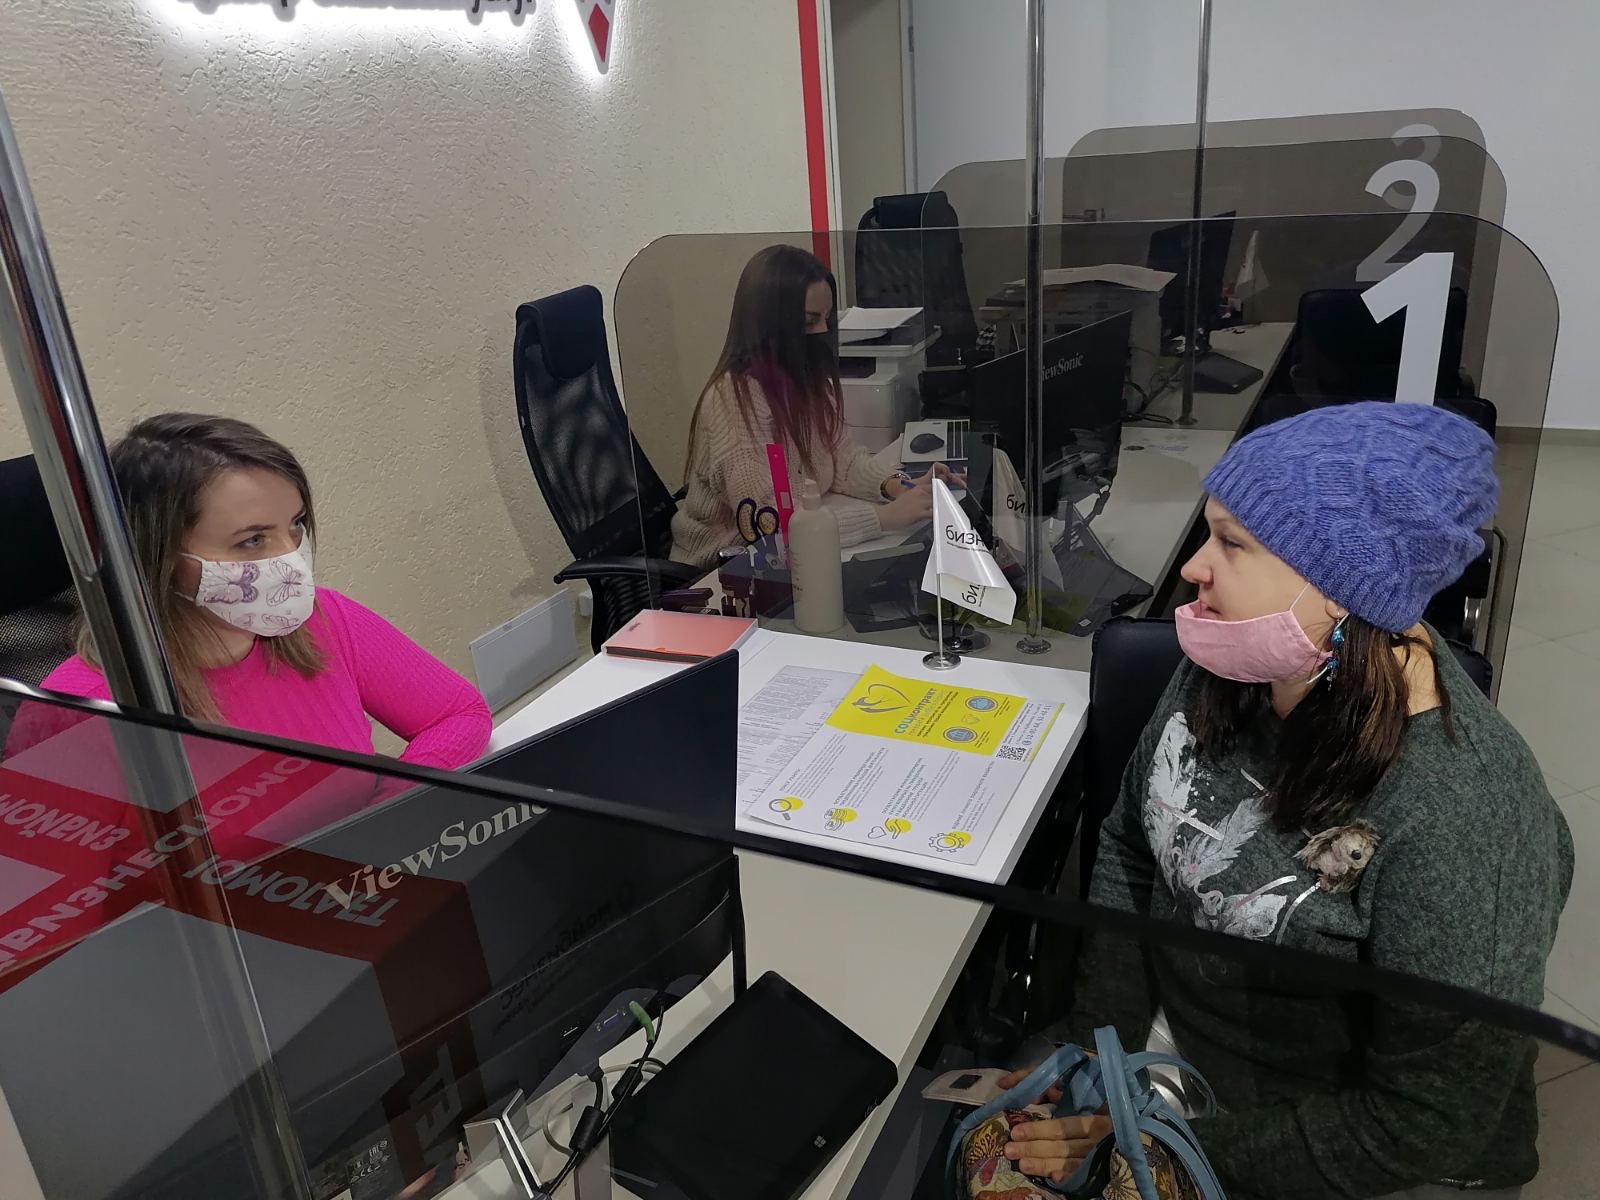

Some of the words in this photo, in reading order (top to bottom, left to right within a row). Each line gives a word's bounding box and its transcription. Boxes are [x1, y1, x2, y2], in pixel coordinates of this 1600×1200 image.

[1356, 160, 1440, 281] 2
[1041, 352, 1084, 382] iewSonic
[1360, 252, 1454, 405] 1
